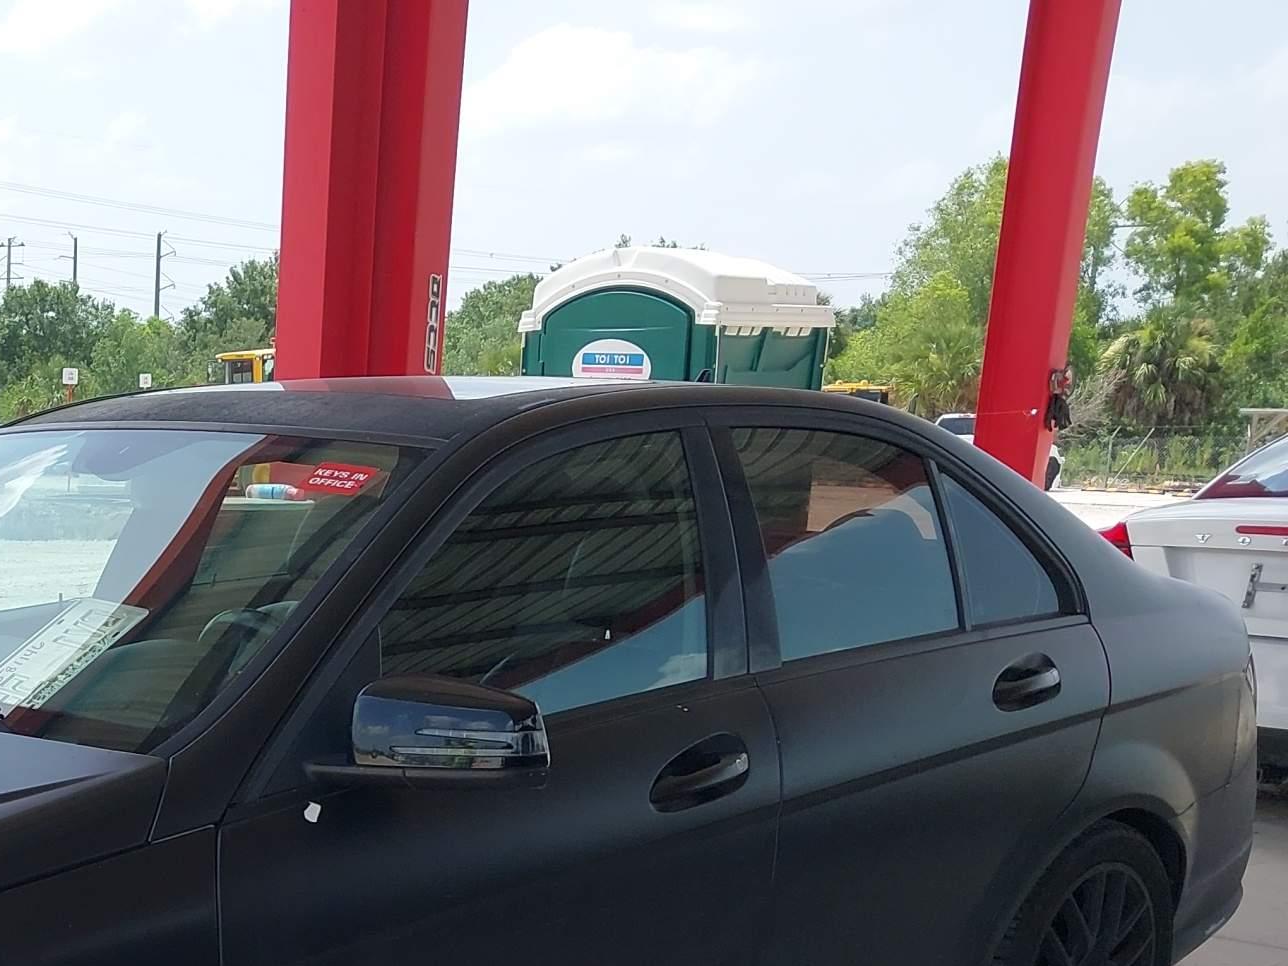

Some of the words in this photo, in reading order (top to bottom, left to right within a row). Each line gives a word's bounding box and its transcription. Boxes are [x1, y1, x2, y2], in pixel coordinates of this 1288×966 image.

[313, 468, 350, 479] KEYS
[351, 473, 369, 481] IN
[308, 477, 354, 489] OFFICE
